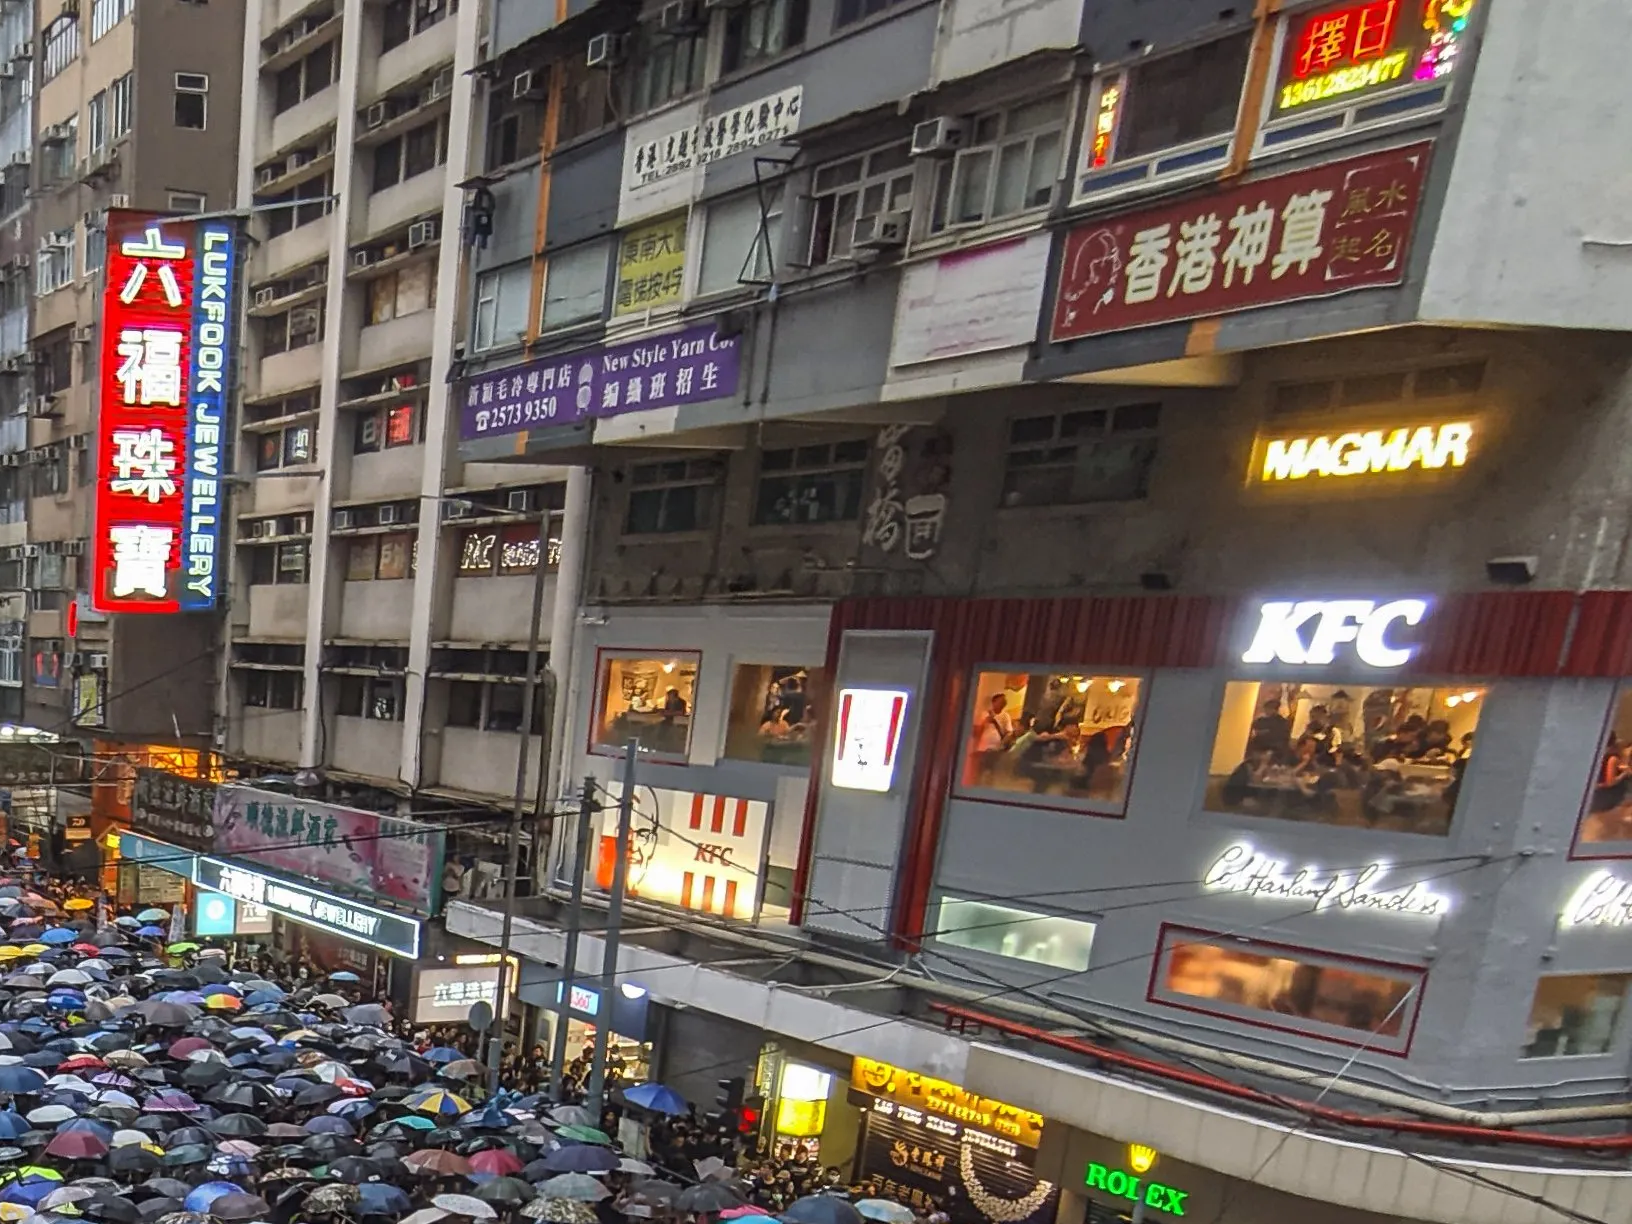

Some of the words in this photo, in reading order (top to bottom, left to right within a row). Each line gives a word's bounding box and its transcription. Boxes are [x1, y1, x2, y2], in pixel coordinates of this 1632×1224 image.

[1301, 1, 1396, 76] 擇日
[1341, 180, 1408, 219] 風水
[1124, 189, 1334, 305] 香港神算
[1331, 228, 1396, 264] 起名
[195, 230, 229, 394] LUKFOOK
[601, 354, 628, 375] New
[631, 344, 667, 369] Style
[671, 336, 705, 360] Yarn
[109, 228, 186, 598] 六福珠寶
[491, 405, 522, 428] 2573
[525, 396, 557, 423] 9350
[1261, 421, 1473, 482] MAGMAR
[187, 402, 222, 598] JEWELLERY
[1242, 598, 1428, 667] KFC
[693, 840, 734, 867] KFC
[1084, 1161, 1190, 1218] ROLEX
